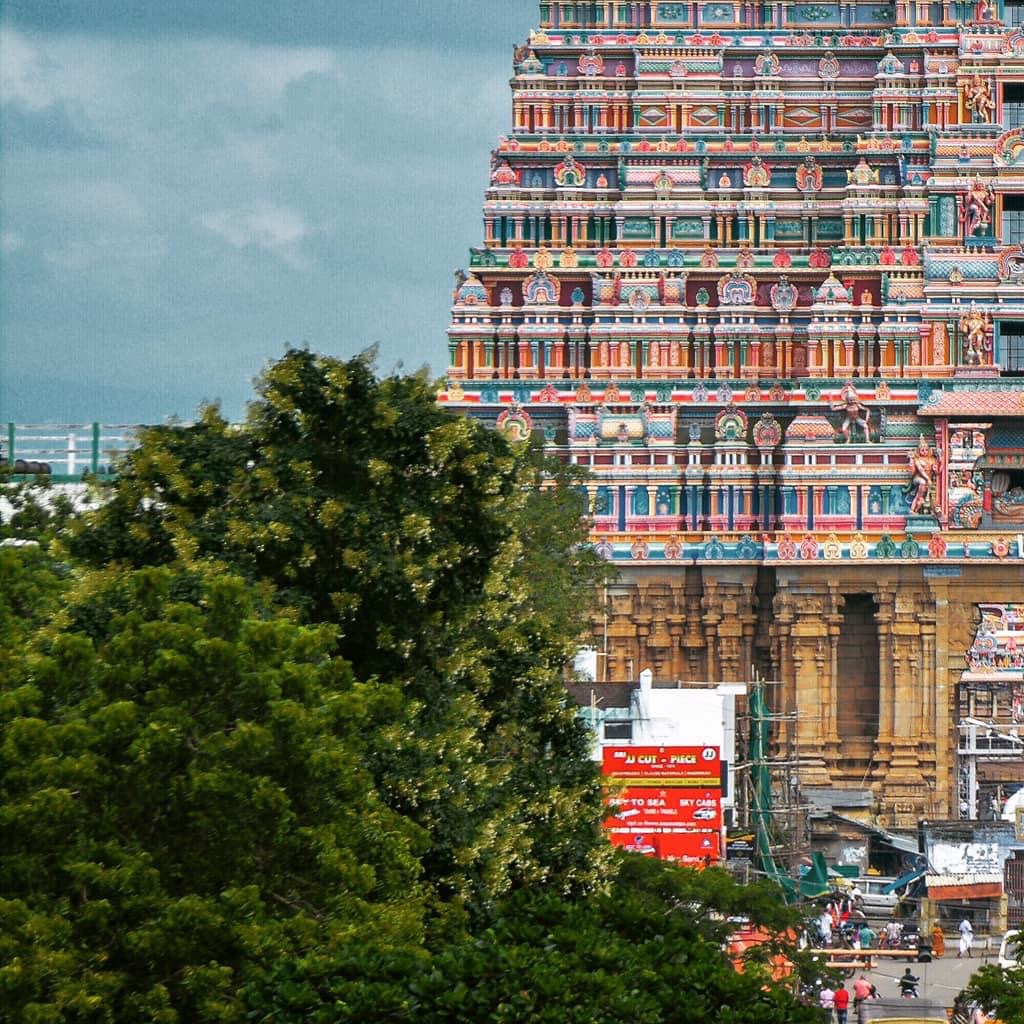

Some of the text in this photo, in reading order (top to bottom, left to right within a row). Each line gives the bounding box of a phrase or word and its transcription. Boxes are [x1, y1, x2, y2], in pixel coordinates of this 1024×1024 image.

[638, 755, 657, 764] CUT
[670, 755, 697, 764] PIECE
[696, 799, 717, 807] CABS
